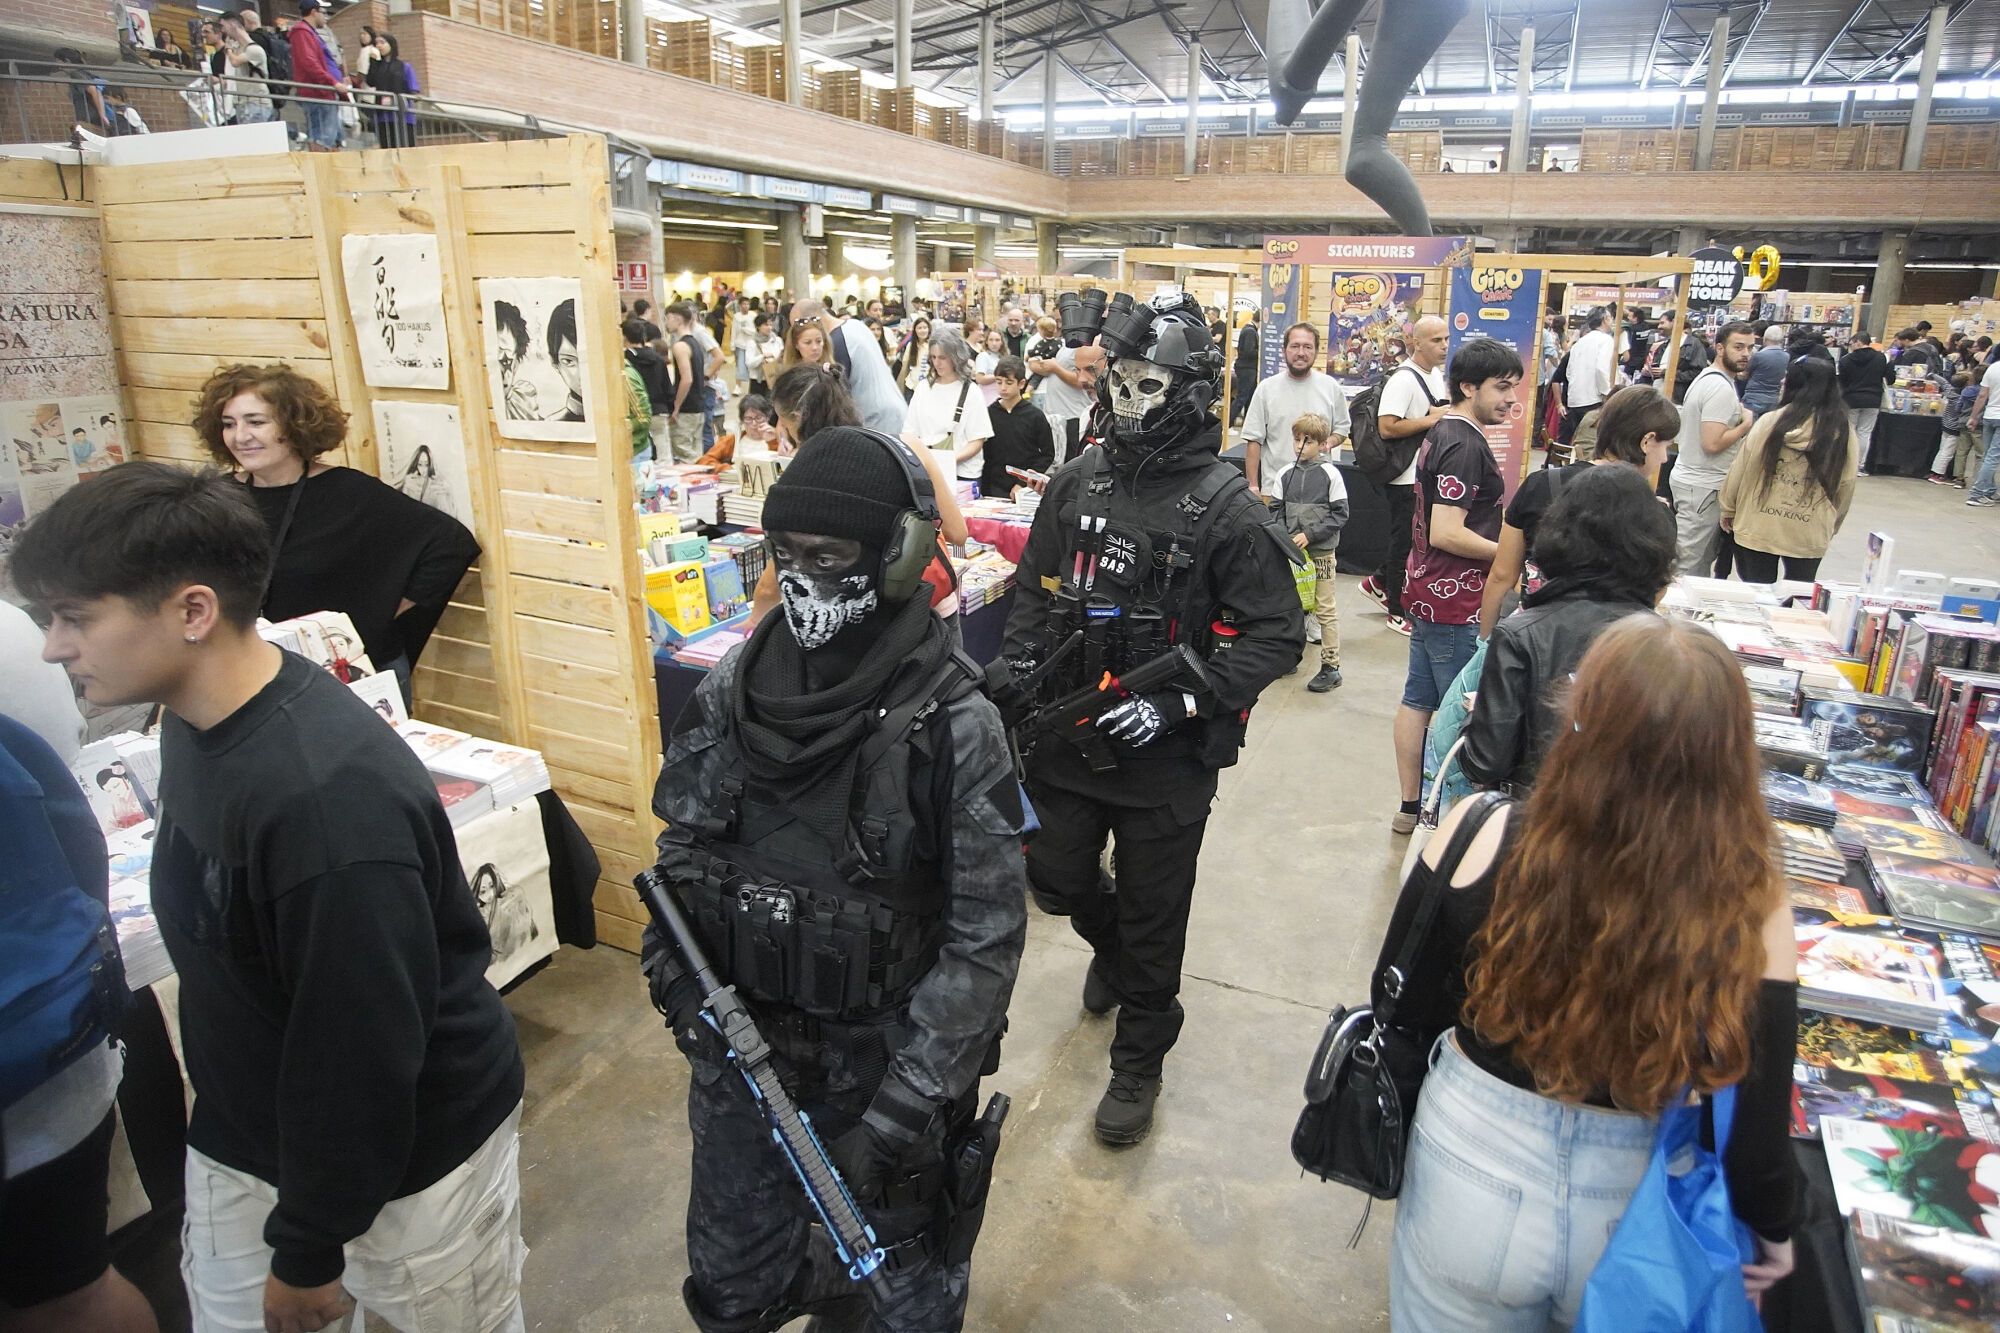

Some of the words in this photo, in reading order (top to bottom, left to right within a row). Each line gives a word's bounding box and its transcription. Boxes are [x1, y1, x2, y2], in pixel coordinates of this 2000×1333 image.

[1327, 244, 1416, 258] SIGNATURES
[1694, 260, 1738, 274] REAK
[1690, 274, 1735, 288] HOW
[408, 322, 432, 332] HAIKUS
[1760, 506, 1782, 517] LION
[1783, 510, 1812, 523] KING
[1100, 556, 1126, 574] SAS
